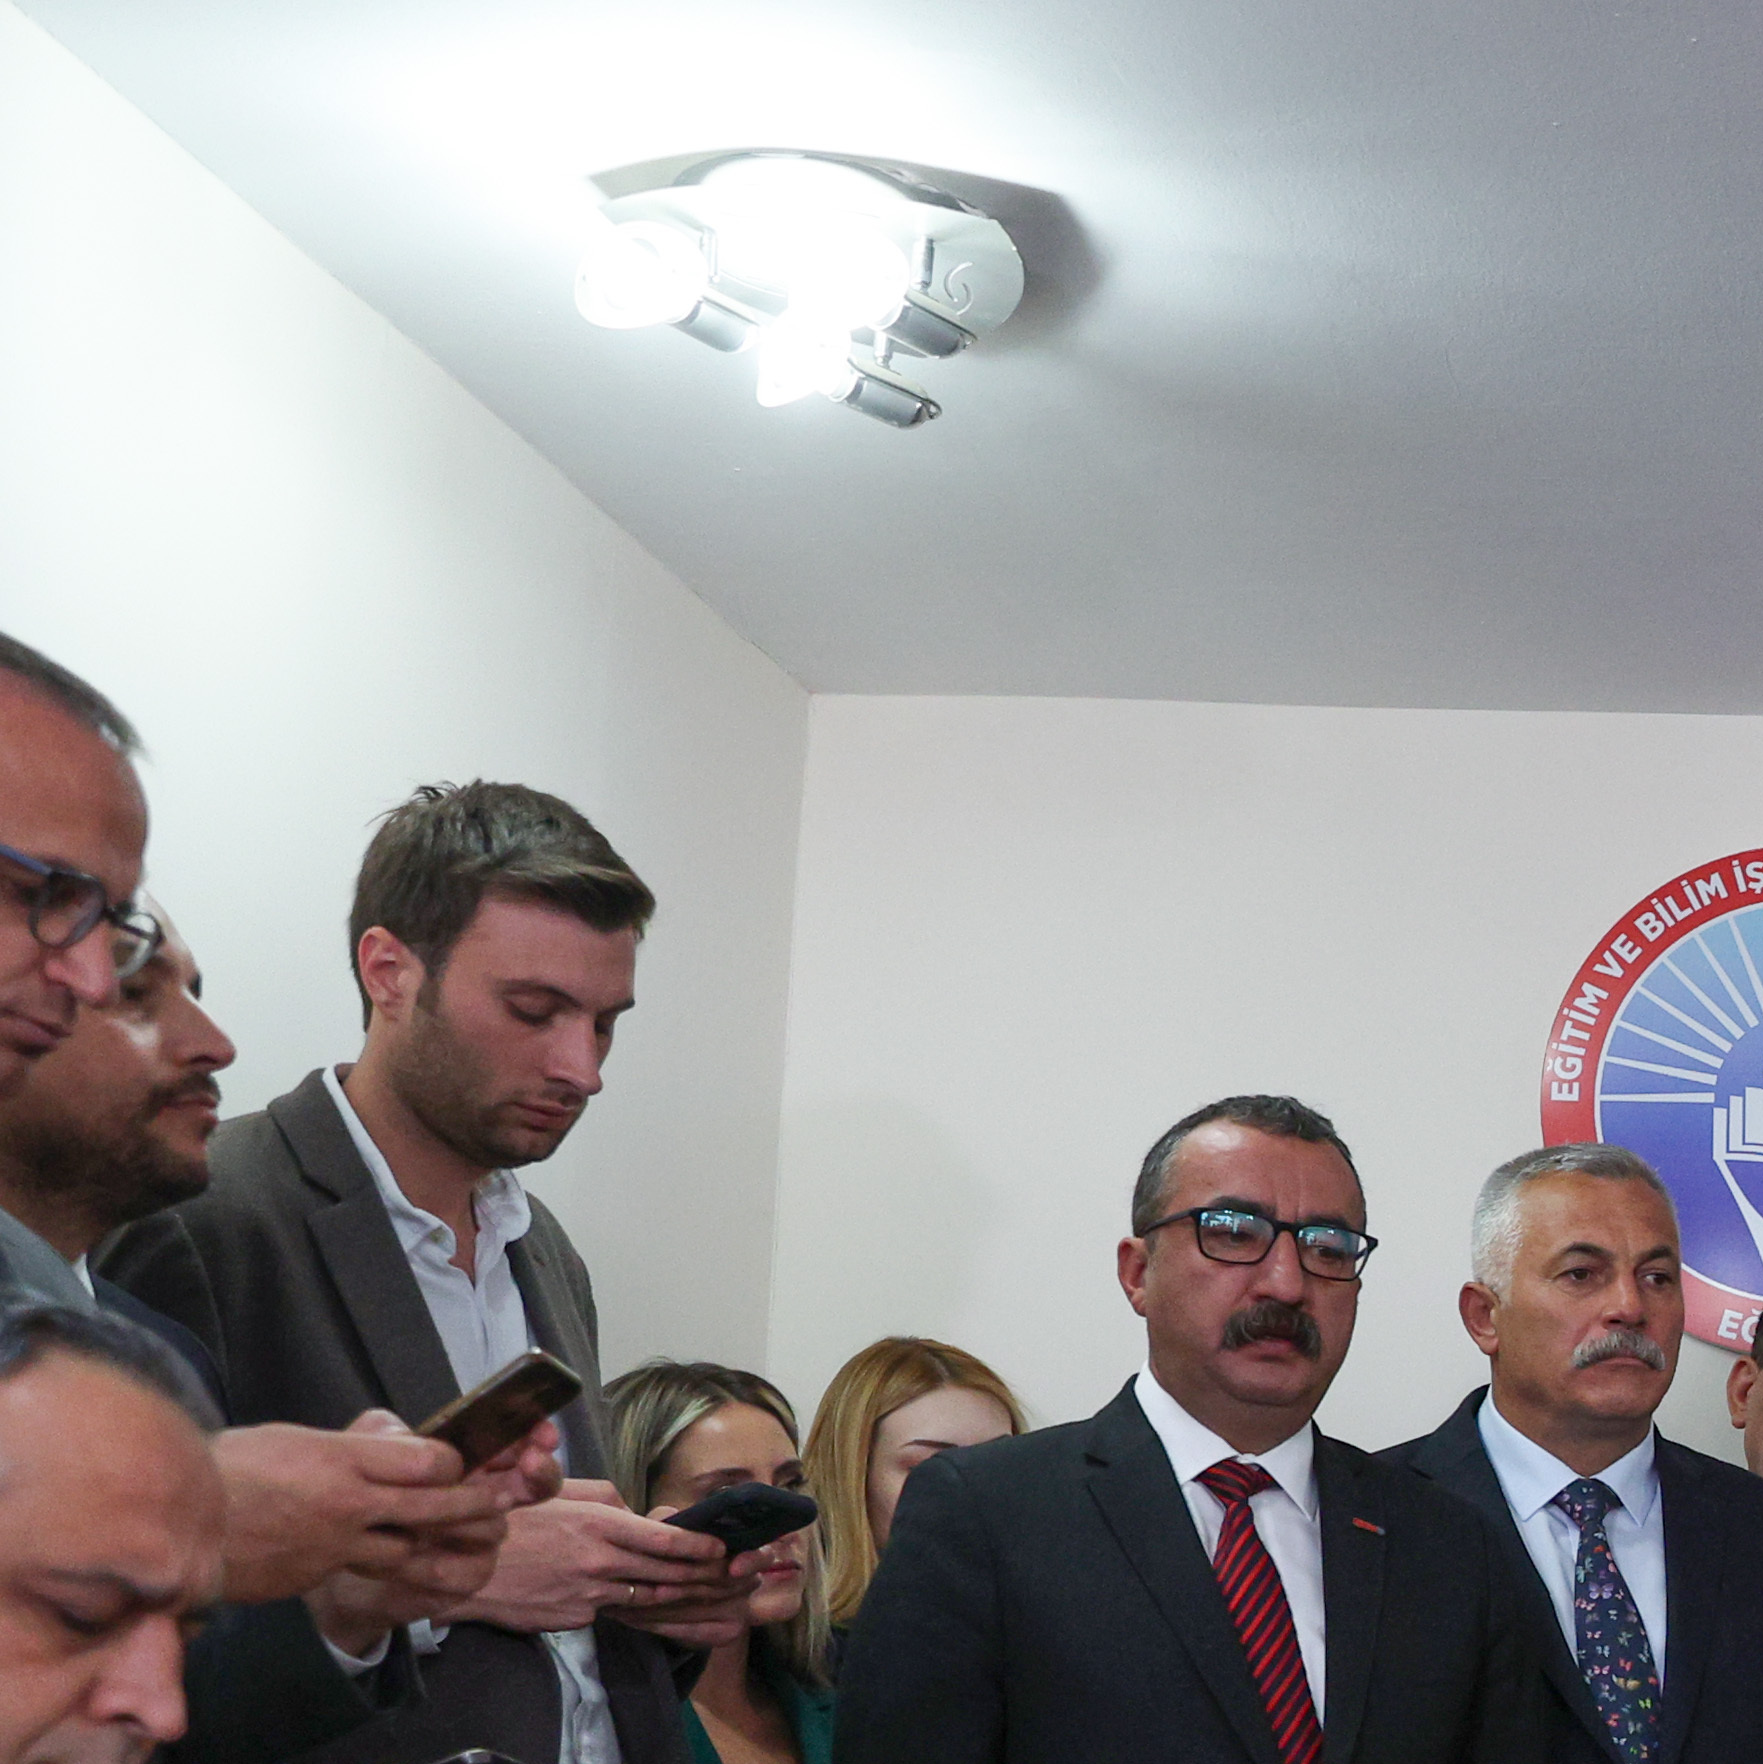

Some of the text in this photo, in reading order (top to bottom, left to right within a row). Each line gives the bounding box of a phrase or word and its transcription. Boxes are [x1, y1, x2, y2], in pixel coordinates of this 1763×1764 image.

[1546, 982, 1610, 1102] EĞİTİM
[1593, 934, 1643, 979] VE
[1634, 872, 1729, 943] BİLİM
